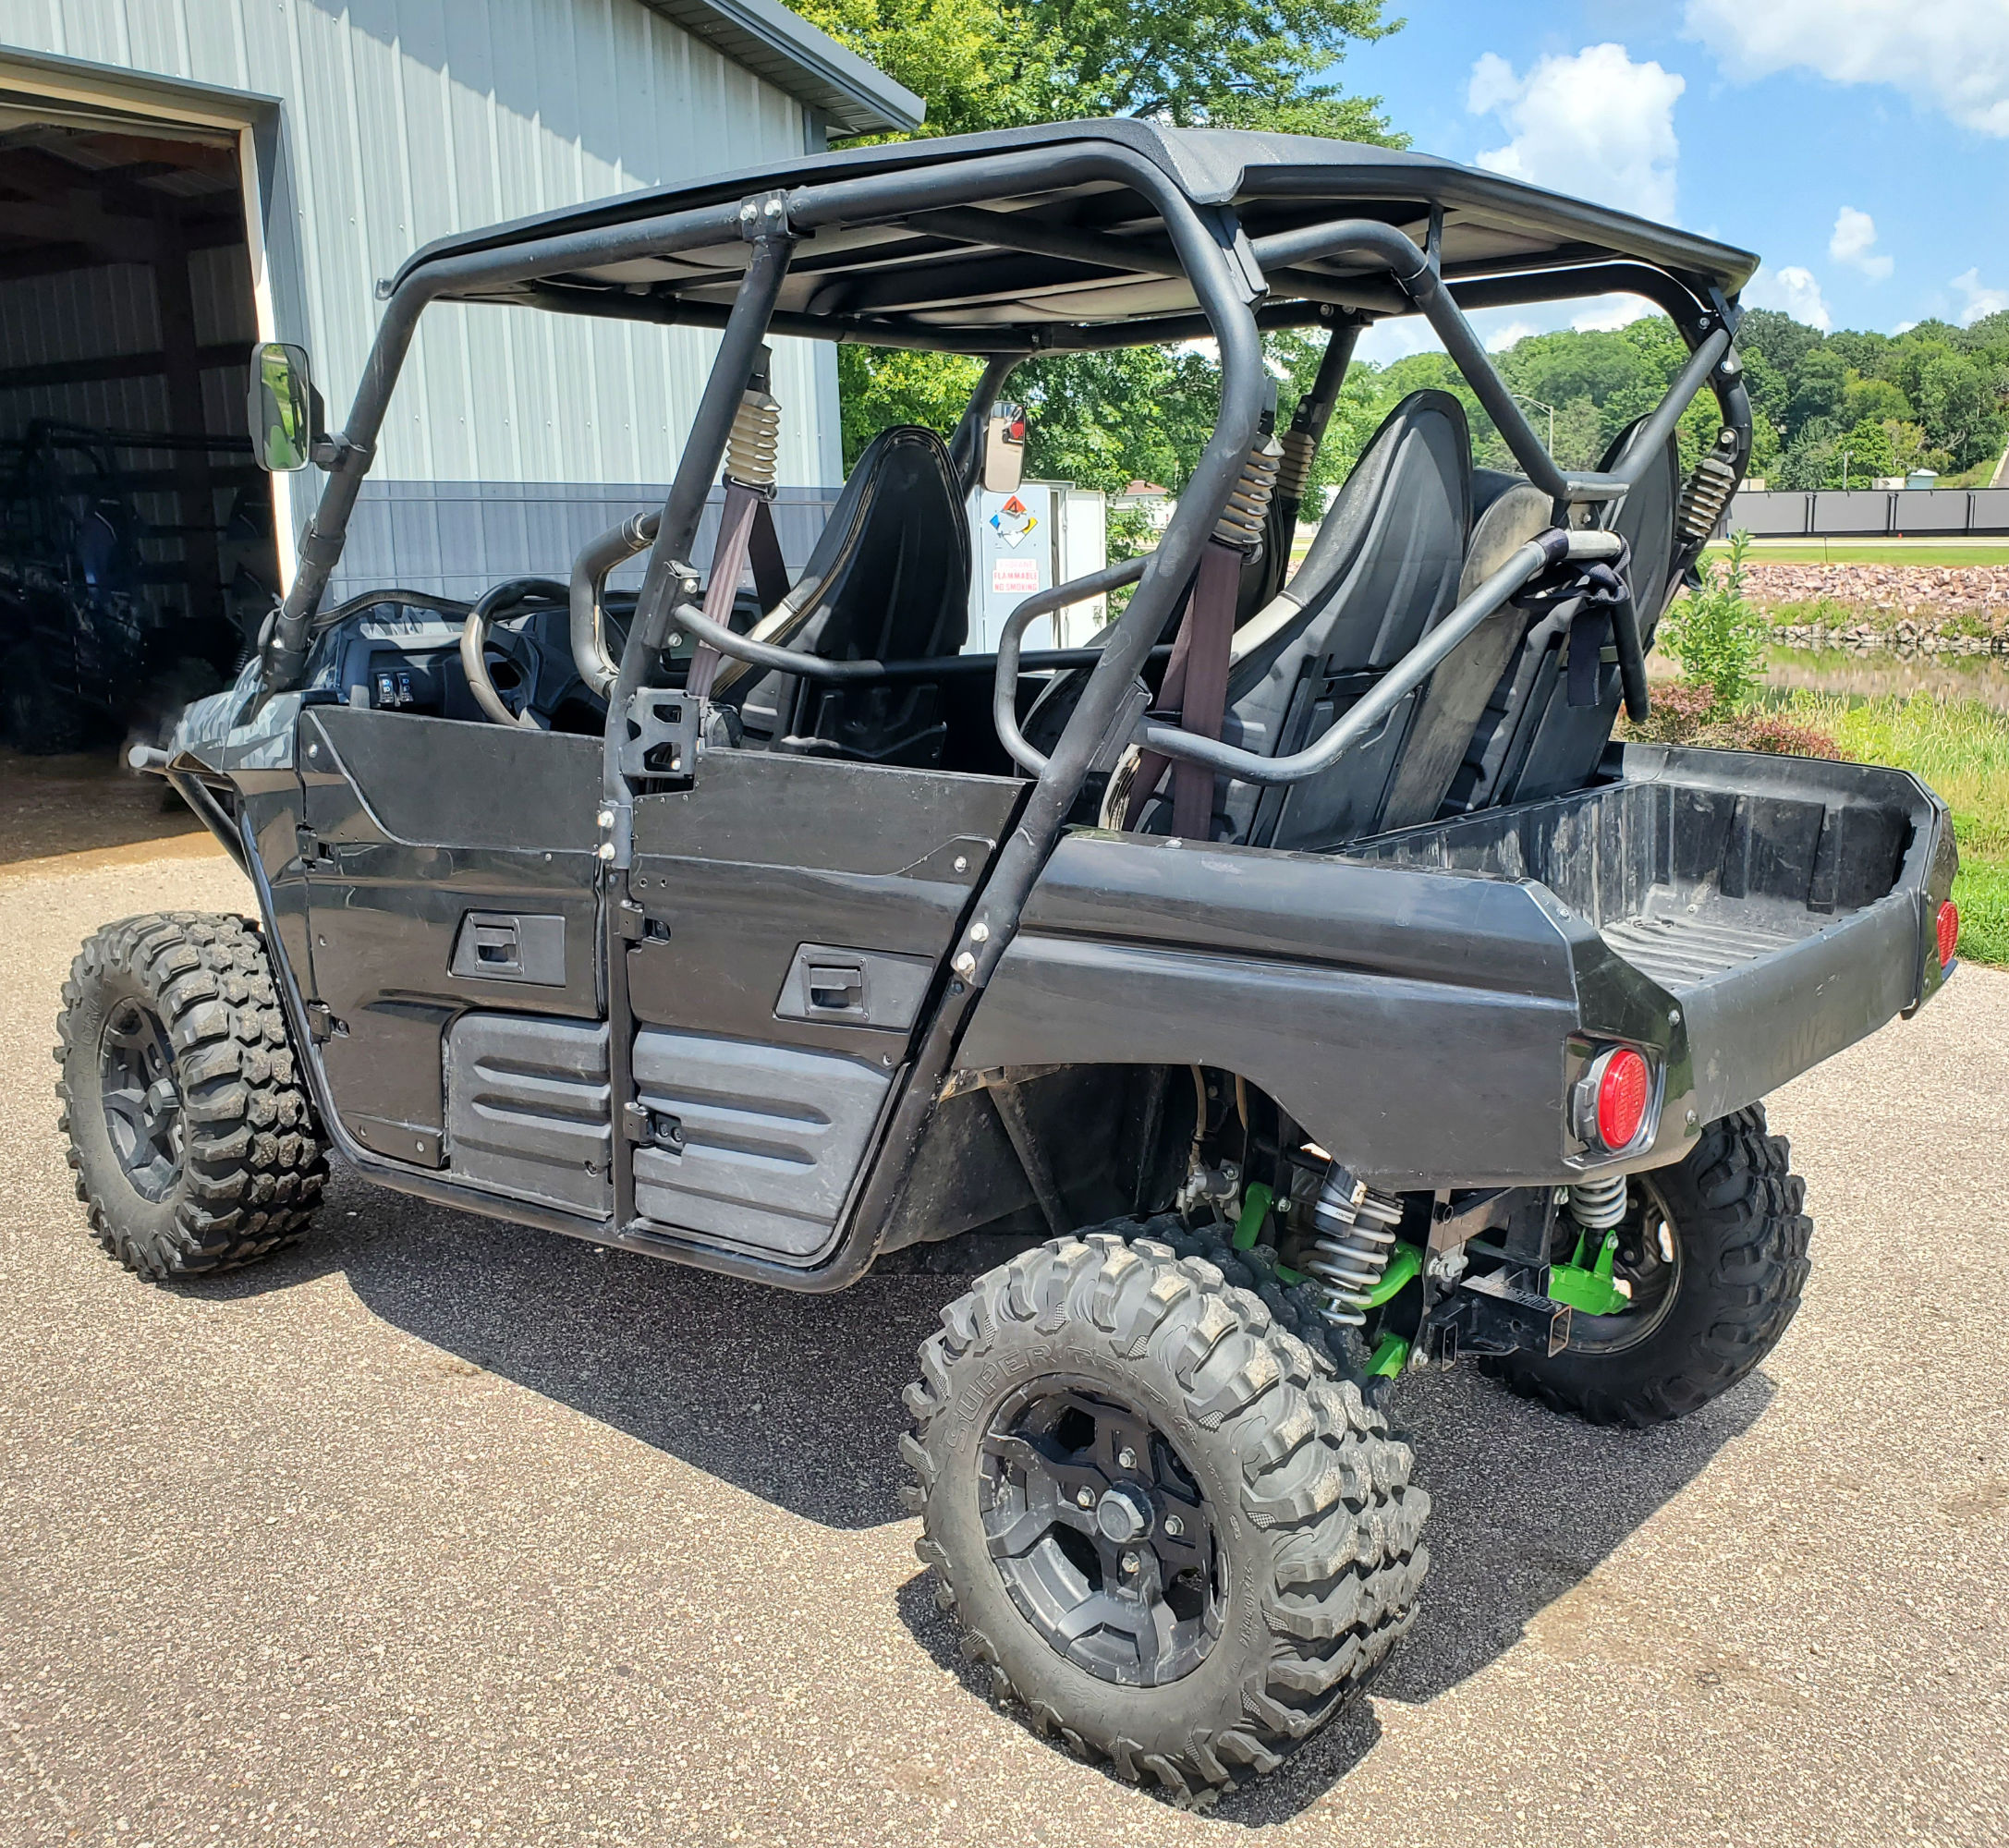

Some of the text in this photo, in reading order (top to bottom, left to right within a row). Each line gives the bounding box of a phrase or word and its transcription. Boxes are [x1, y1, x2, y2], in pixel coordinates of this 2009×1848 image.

[993, 572, 1037, 580] FLAMMABLE
[994, 583, 1037, 591] NO SMOKING
[944, 1343, 1057, 1453] SUPER
